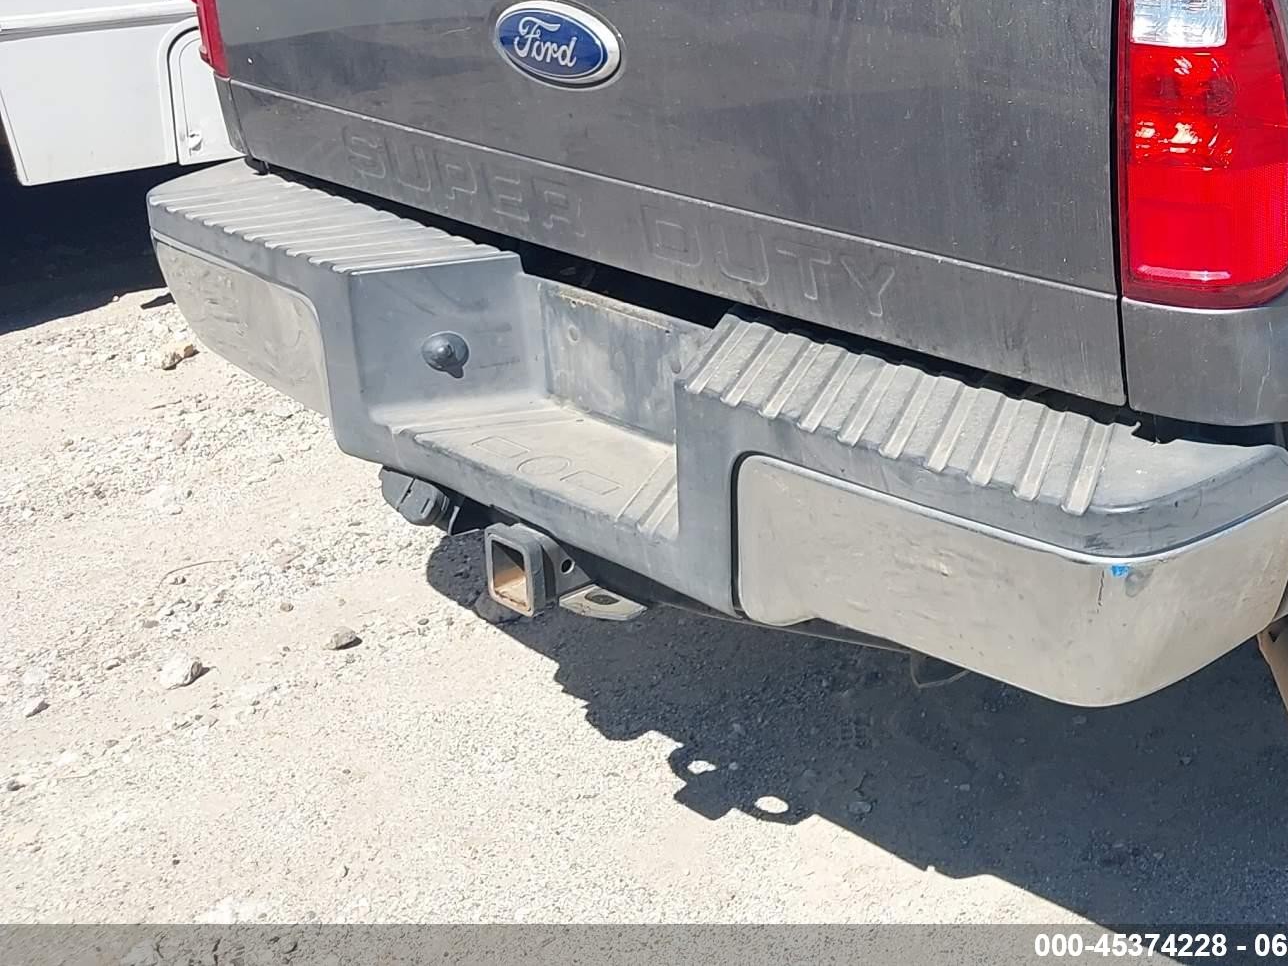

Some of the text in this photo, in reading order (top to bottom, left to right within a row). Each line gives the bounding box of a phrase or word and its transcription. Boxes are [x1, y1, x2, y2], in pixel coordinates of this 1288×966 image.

[513, 16, 578, 68] Ford
[343, 130, 896, 318] SUPER DUTY
